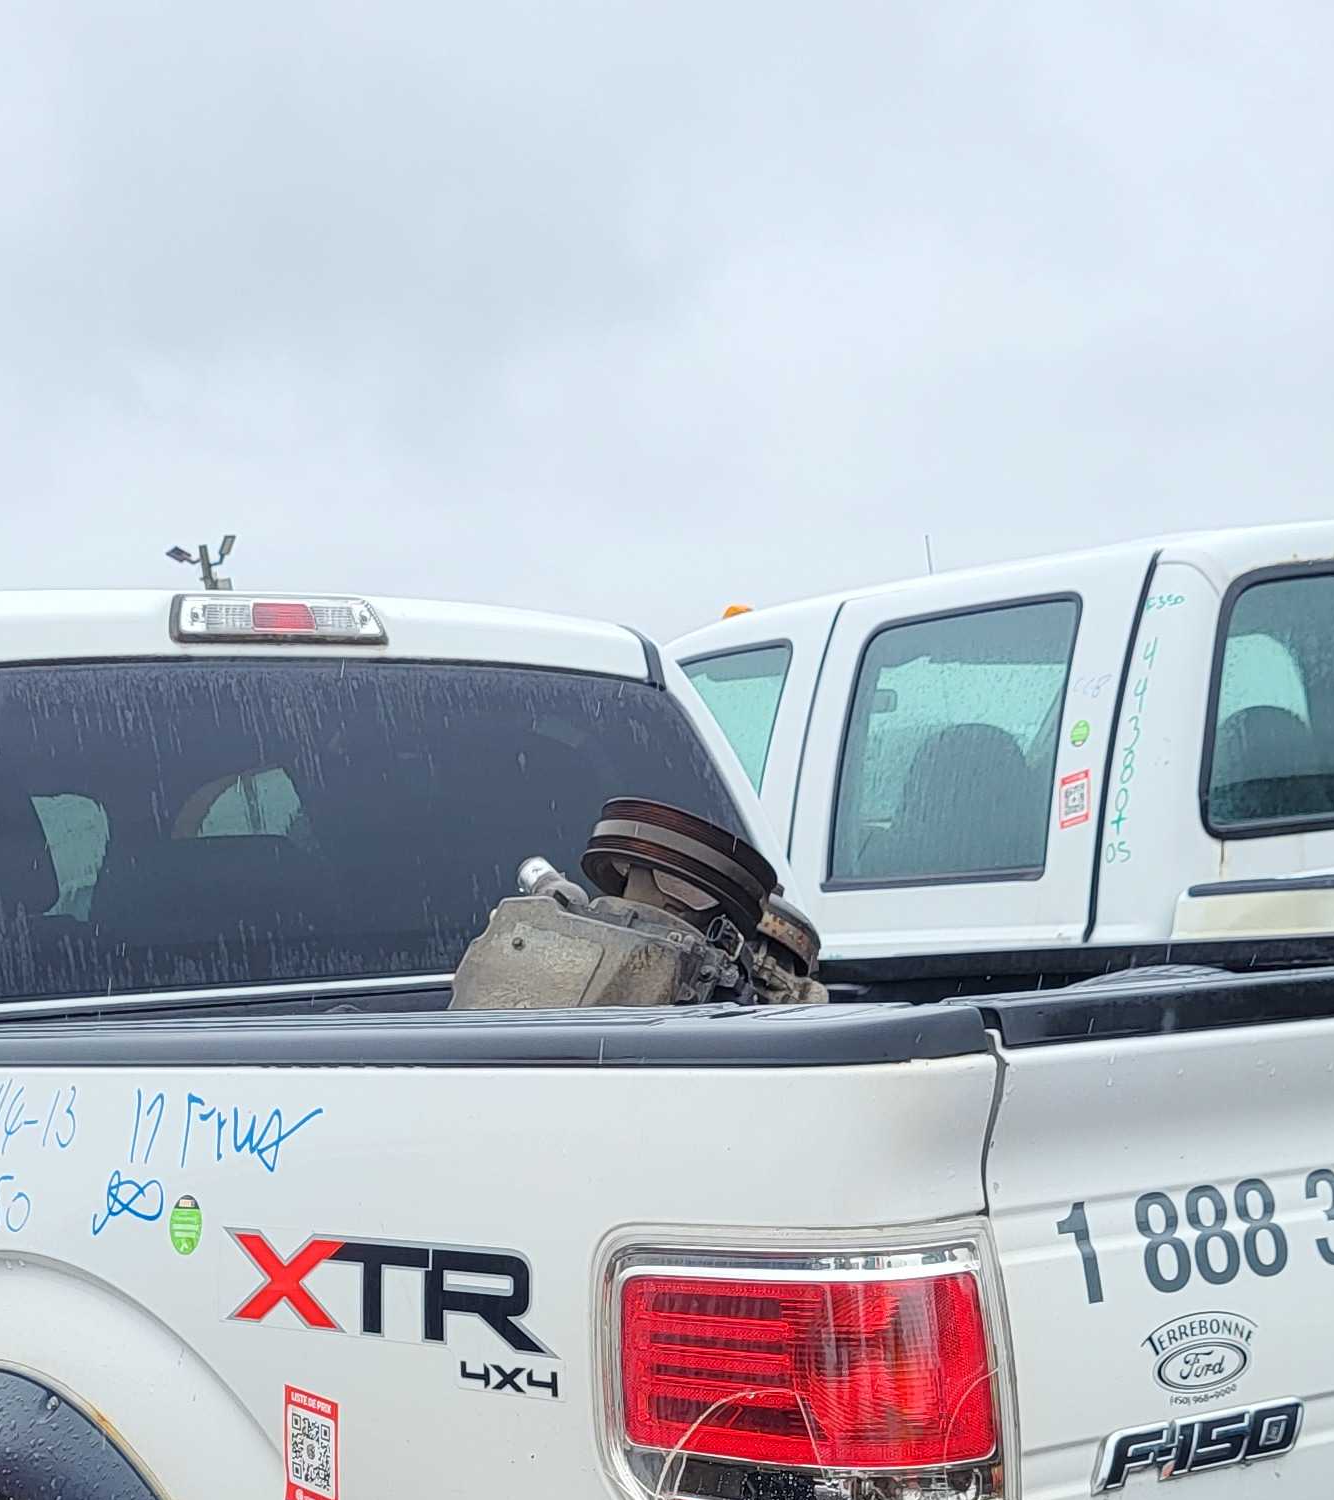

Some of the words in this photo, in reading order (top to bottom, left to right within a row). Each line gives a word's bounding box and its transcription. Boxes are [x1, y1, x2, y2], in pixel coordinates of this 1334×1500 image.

[1056, 1200, 1105, 1305] 1
[1134, 1177, 1290, 1294] 888
[222, 1226, 562, 1360] XTR
[1141, 1316, 1257, 1357] TERREBONNE
[1179, 1349, 1226, 1381] Ford
[1091, 1396, 1305, 1497] F-150
